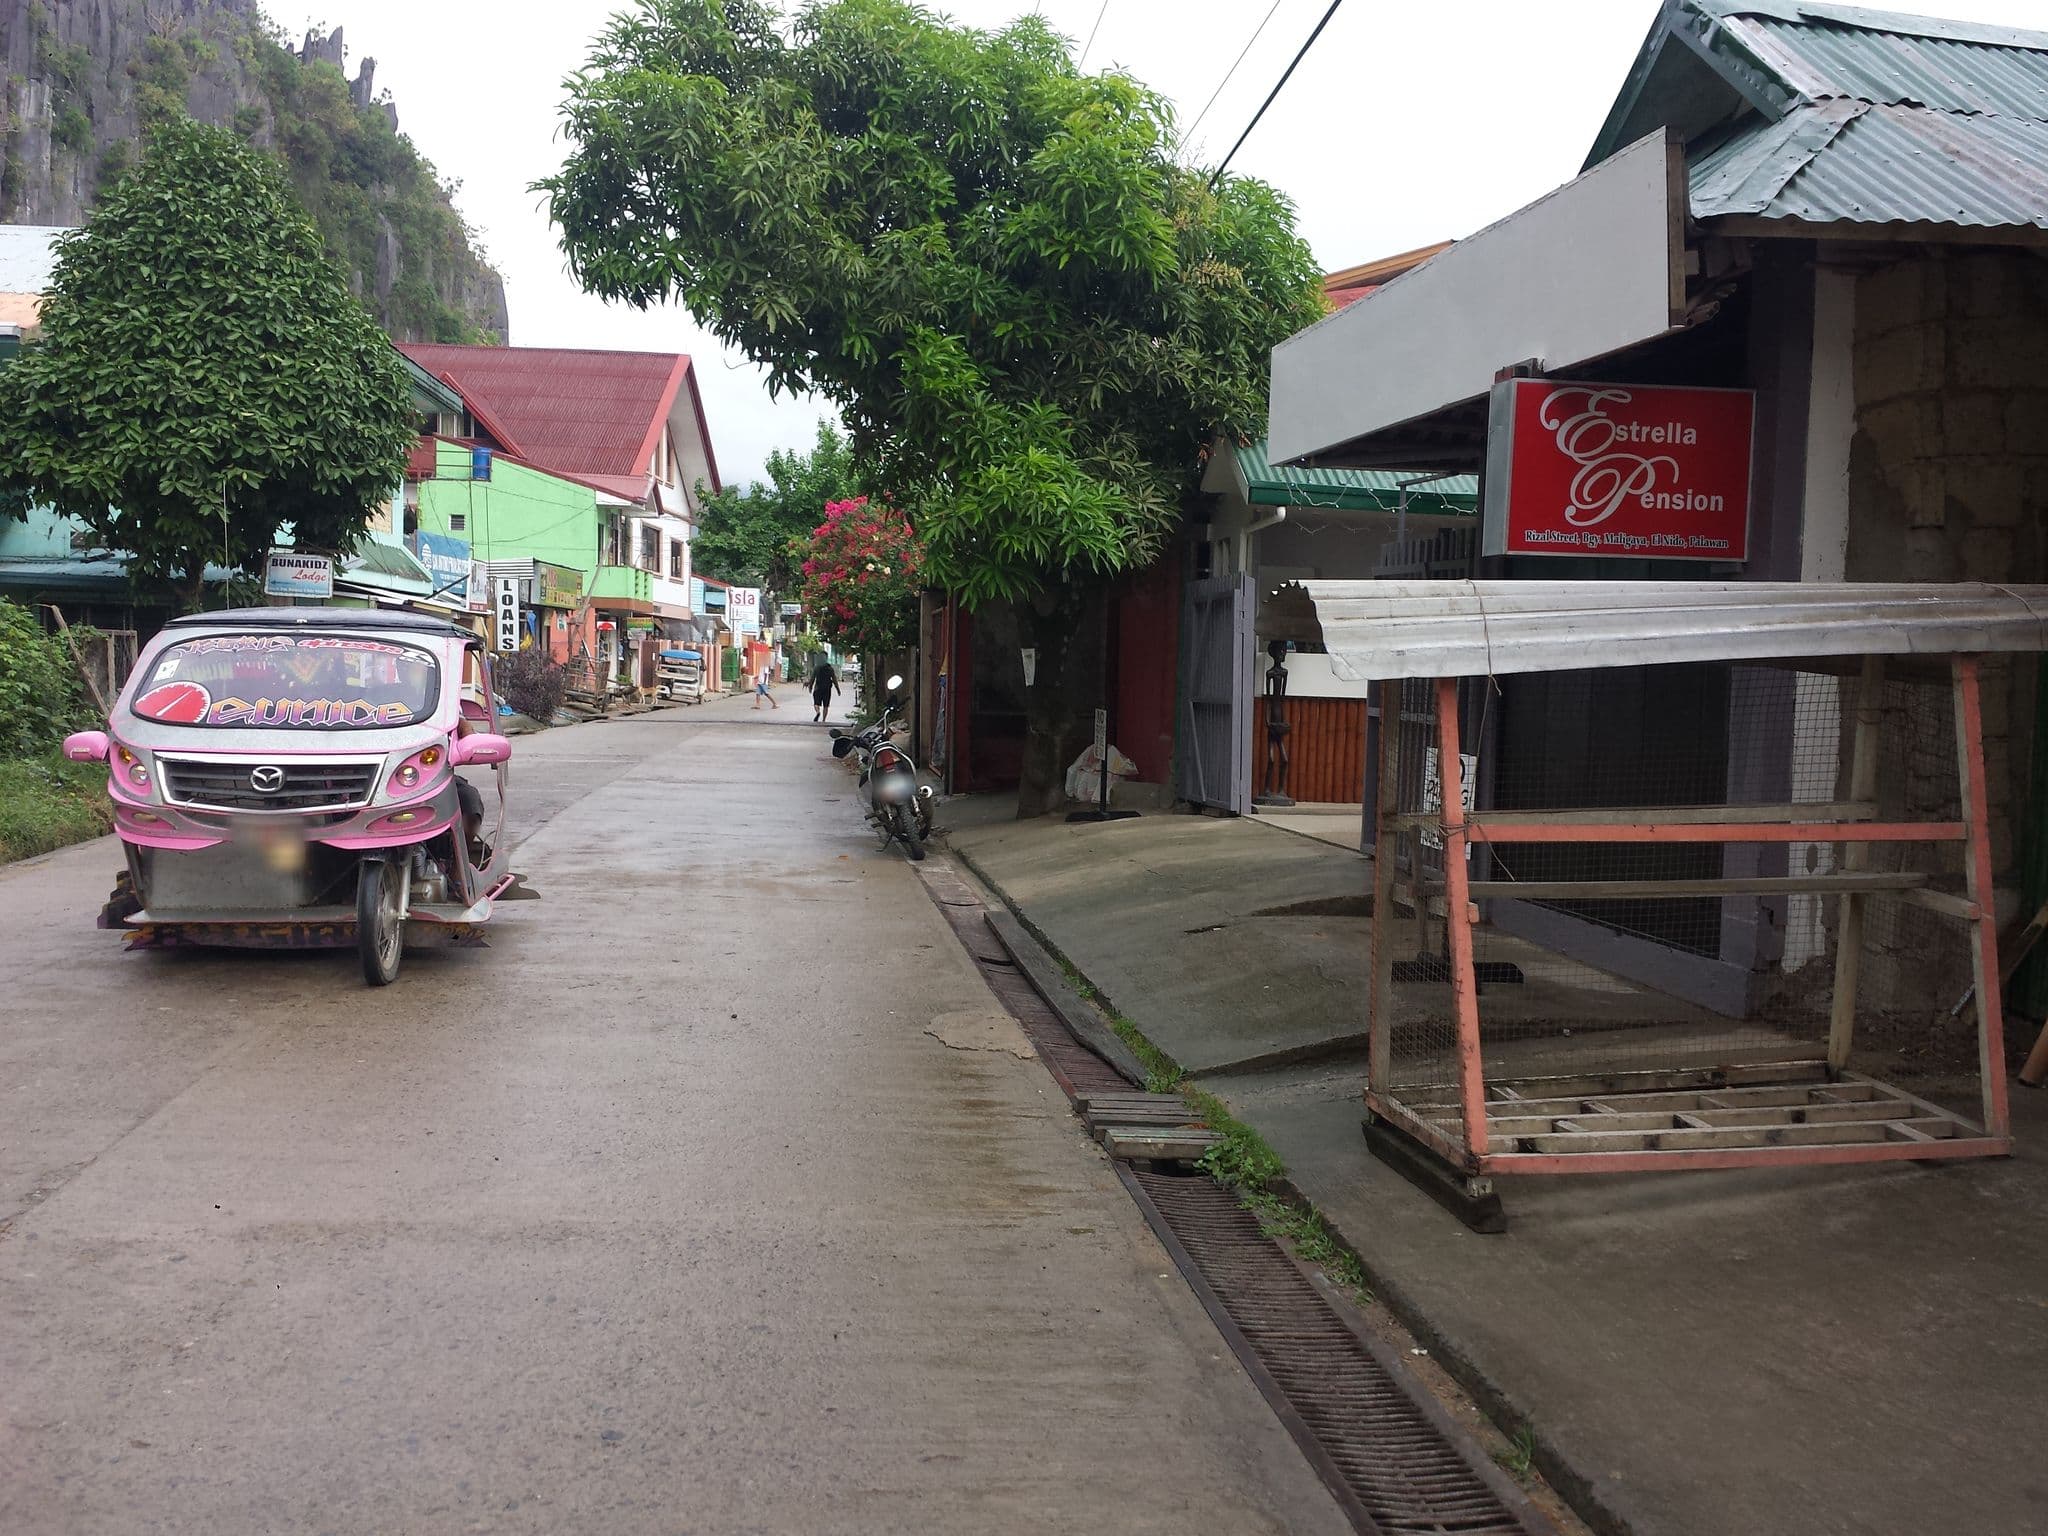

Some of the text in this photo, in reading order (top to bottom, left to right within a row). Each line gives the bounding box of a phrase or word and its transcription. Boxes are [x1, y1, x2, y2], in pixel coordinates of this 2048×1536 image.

[1540, 387, 1697, 464] Estrella
[1565, 453, 1723, 527] Pension
[1525, 530, 1549, 543] Rizal
[1550, 531, 1580, 545] Street,
[1603, 532, 1649, 549] Maligaya,
[1651, 533, 1661, 546] El
[1662, 534, 1688, 548] Nido,
[1689, 535, 1729, 549] Palawan
[271, 558, 329, 570] BUNAKIDZ
[291, 569, 327, 583] Lodge
[501, 579, 514, 650] LOANS
